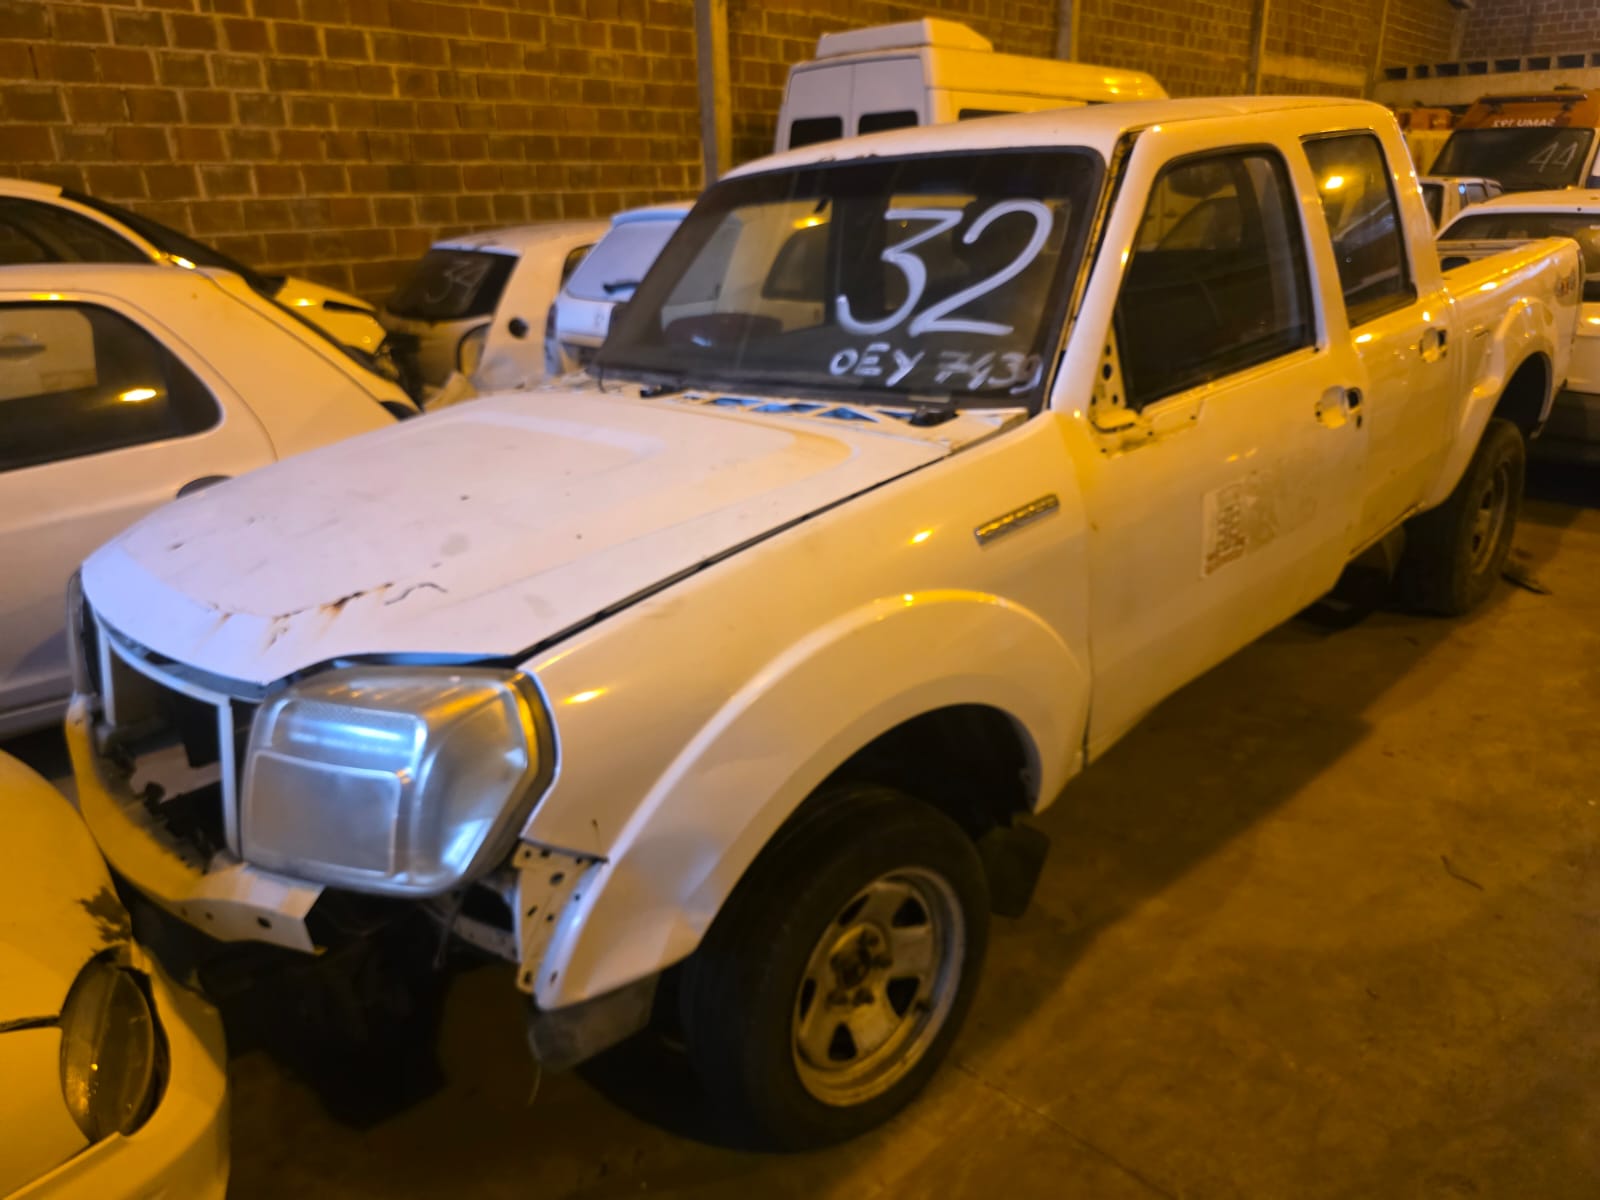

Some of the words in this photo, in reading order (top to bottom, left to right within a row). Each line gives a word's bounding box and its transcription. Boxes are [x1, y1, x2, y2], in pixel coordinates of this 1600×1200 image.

[1528, 141, 1578, 173] 44
[836, 199, 1054, 338] 32
[829, 342, 925, 387] OEY
